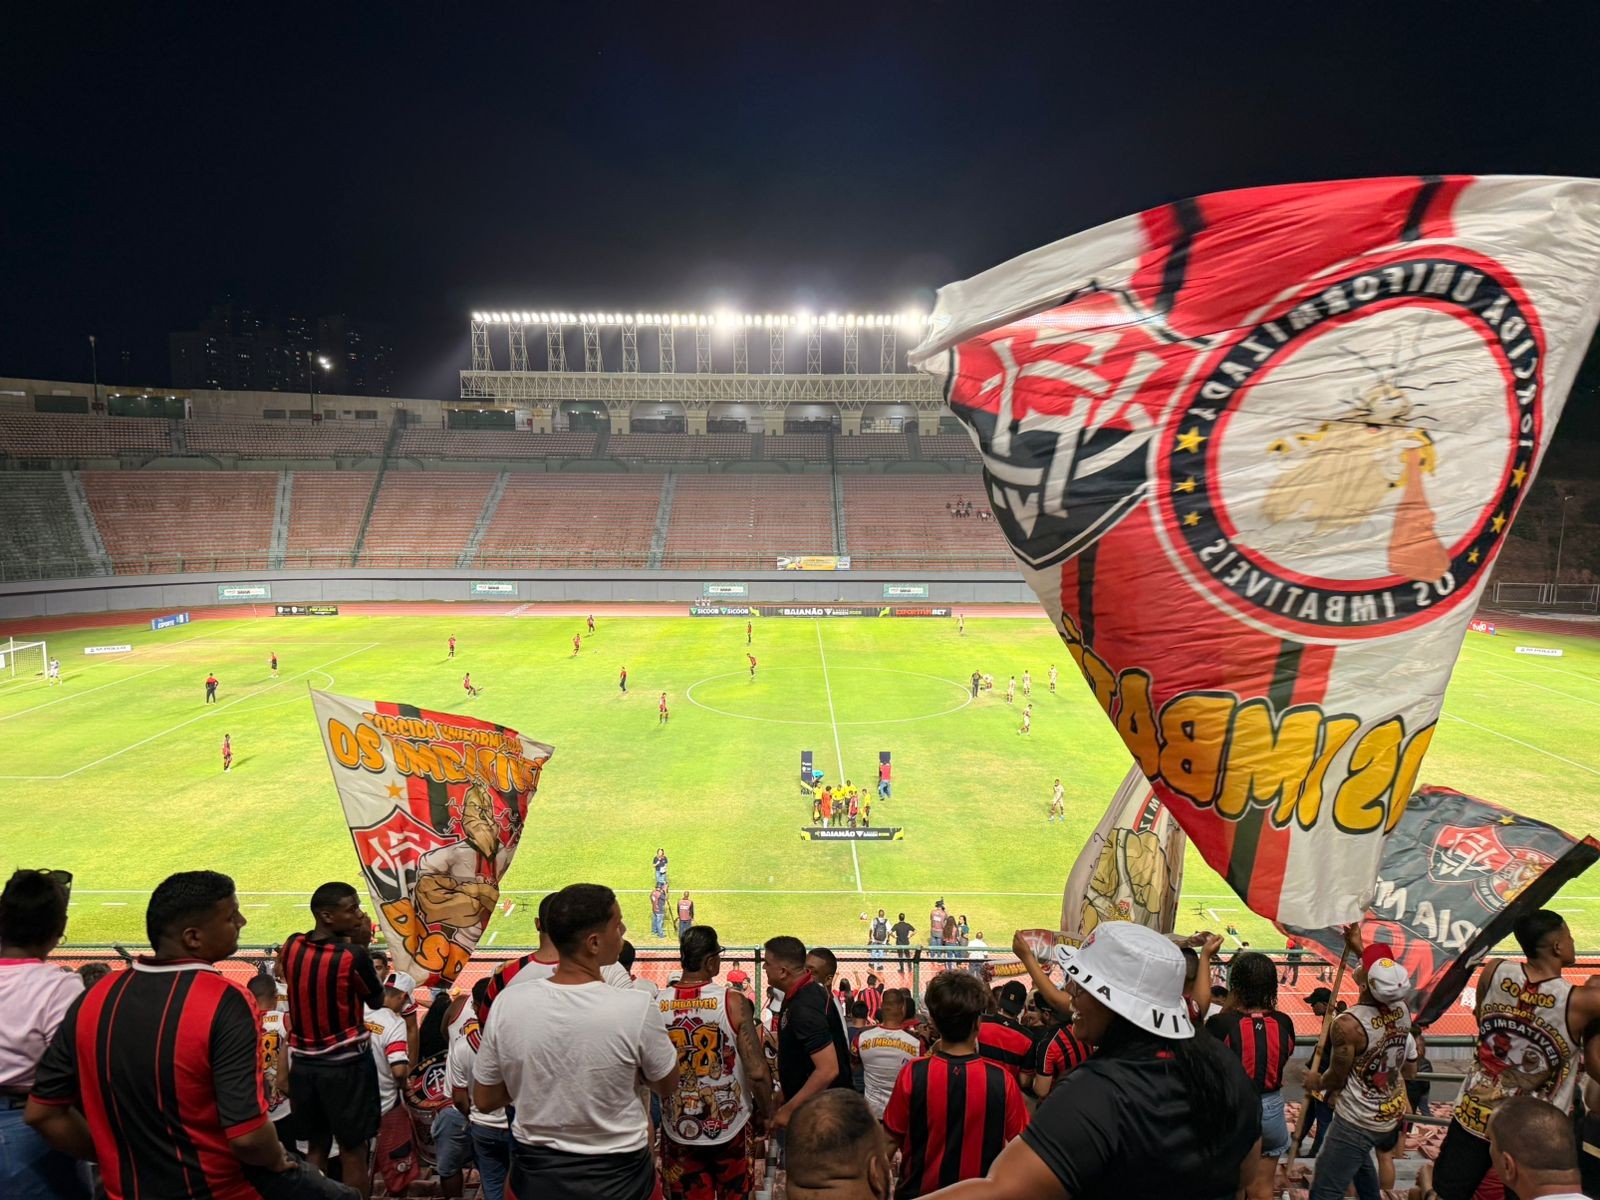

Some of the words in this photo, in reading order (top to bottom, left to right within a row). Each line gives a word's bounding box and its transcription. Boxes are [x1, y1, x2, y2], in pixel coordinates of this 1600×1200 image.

[327, 717, 386, 774] OS
[1500, 977, 1521, 998] 20
[1519, 990, 1556, 1008] ANOS
